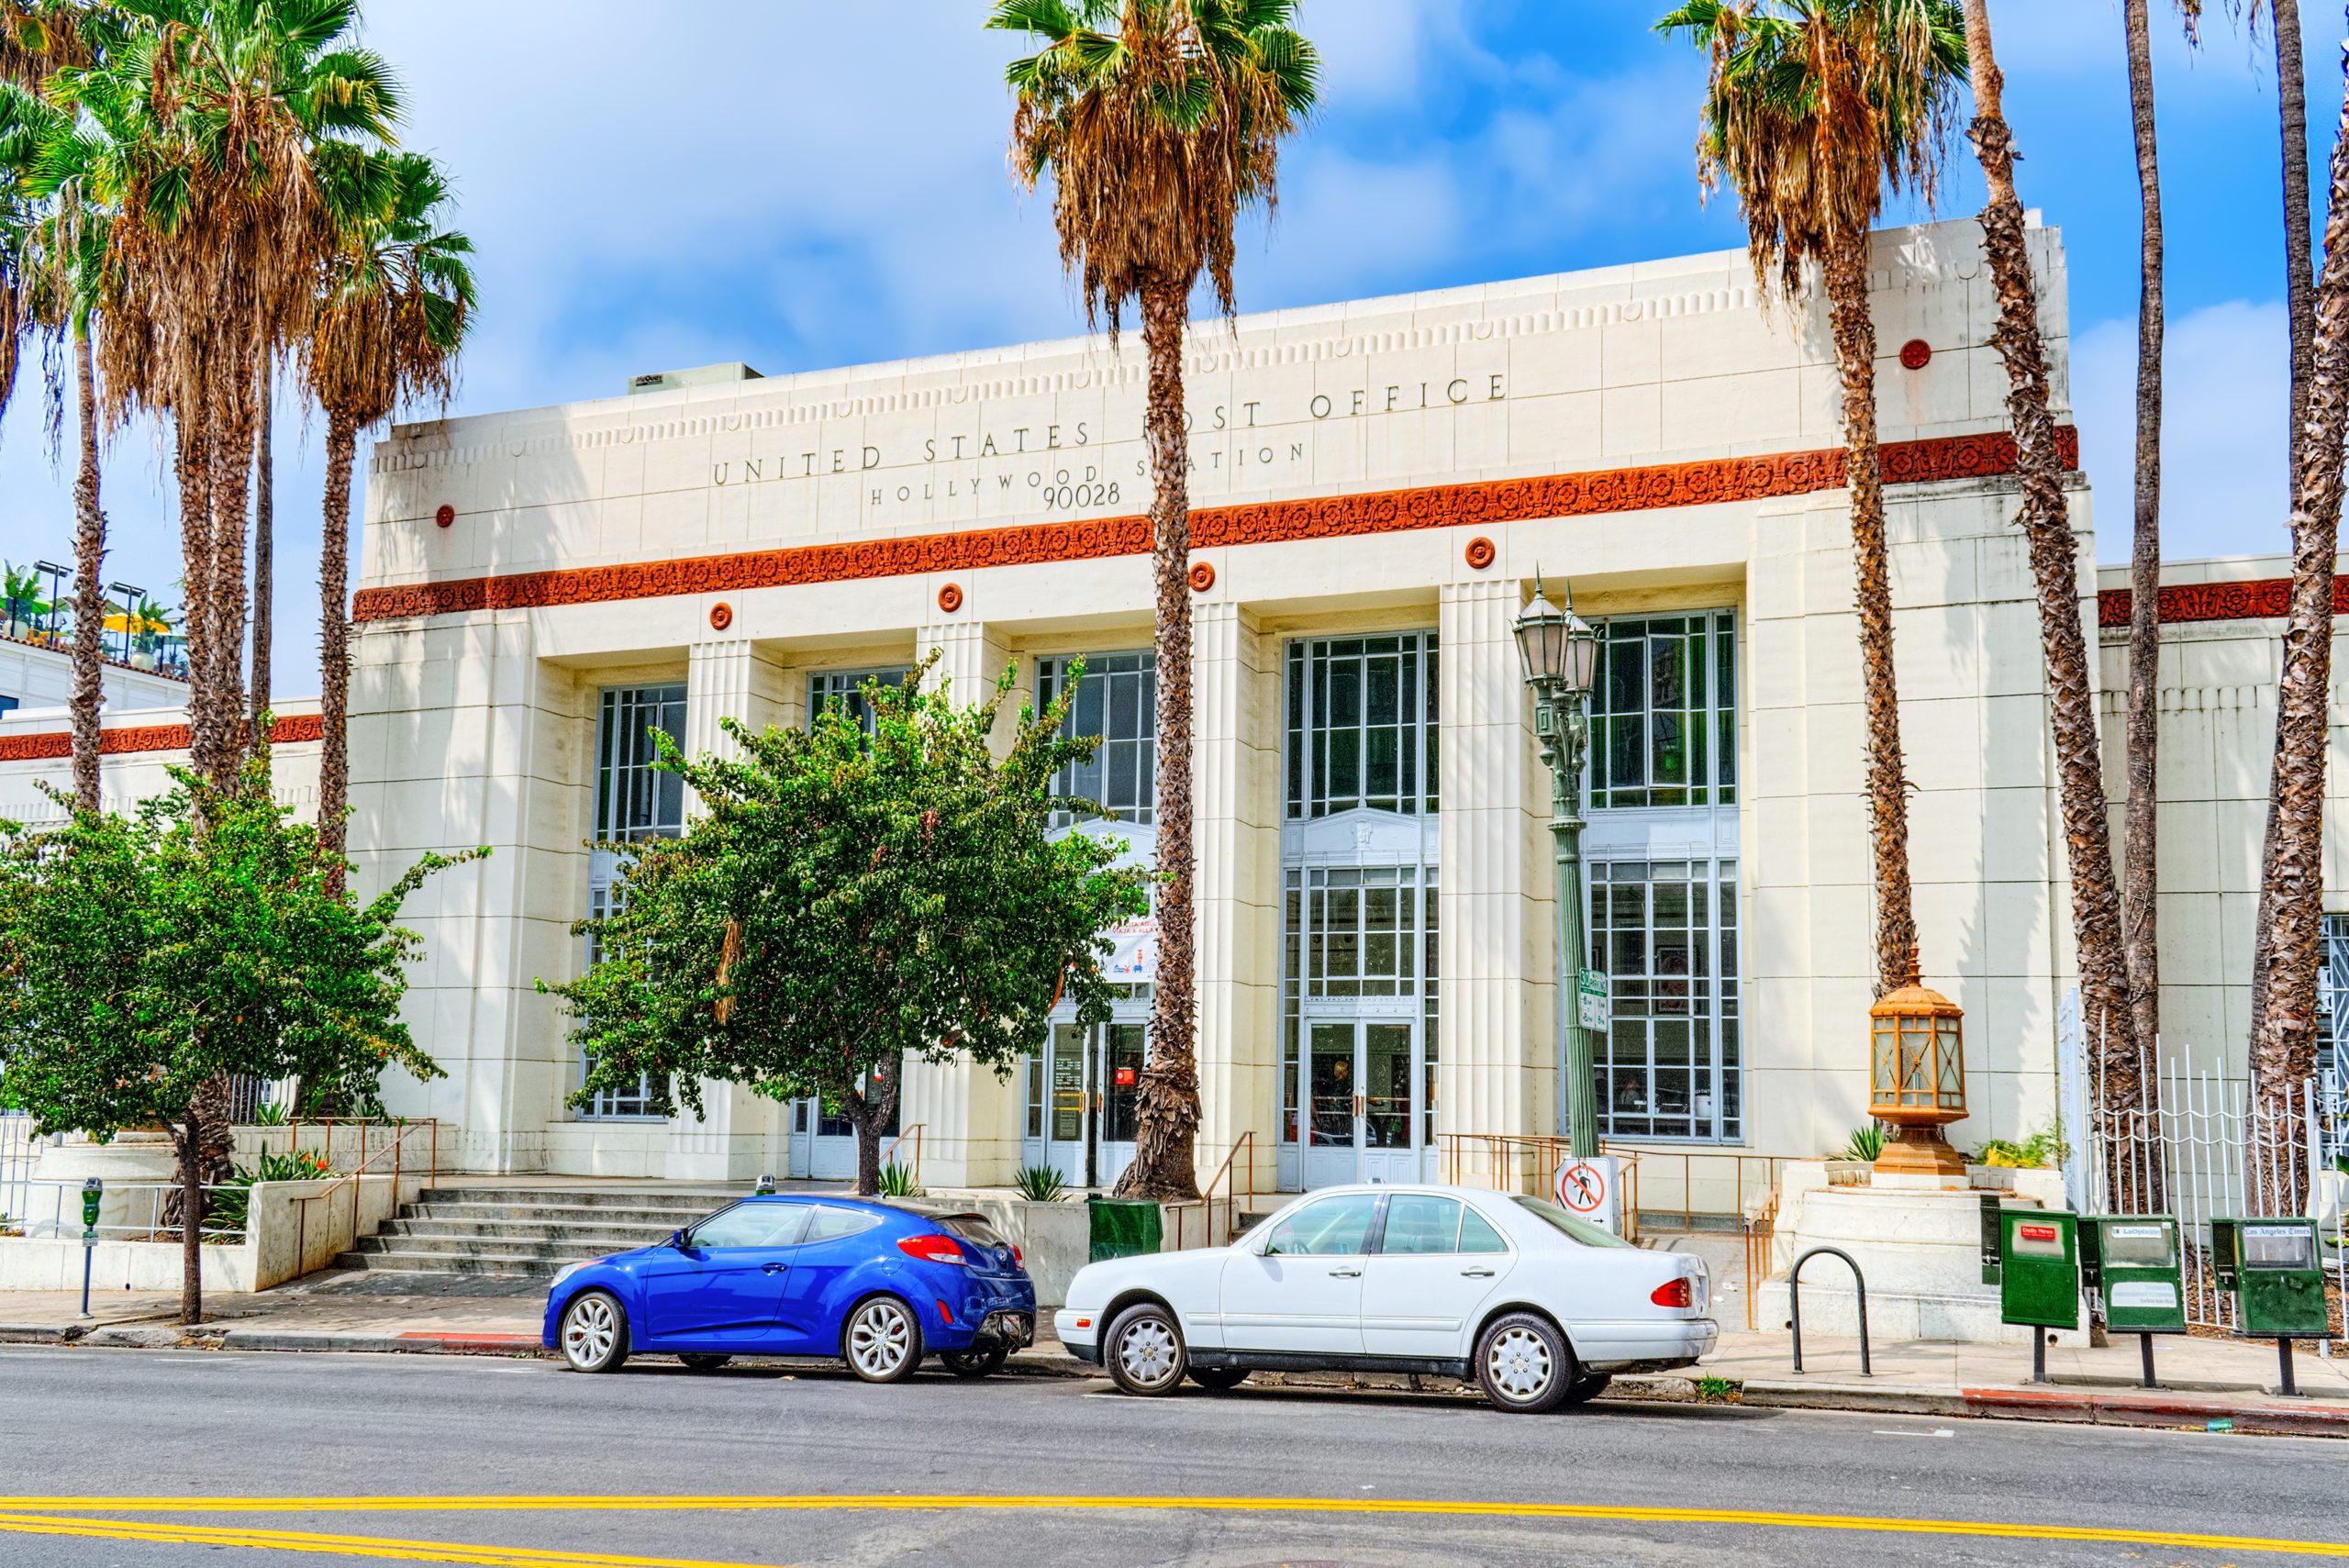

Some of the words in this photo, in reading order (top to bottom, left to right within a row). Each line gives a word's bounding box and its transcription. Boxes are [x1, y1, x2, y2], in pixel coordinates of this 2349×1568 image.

[713, 446, 880, 485] UNITED
[923, 422, 1088, 462] STATES
[1310, 374, 1507, 418] OFFICE
[871, 466, 1097, 506] HOLLYWOOD
[1136, 443, 1303, 476] SATION
[1043, 482, 1120, 511] 90028
[2260, 1228, 2287, 1236] Angeles
